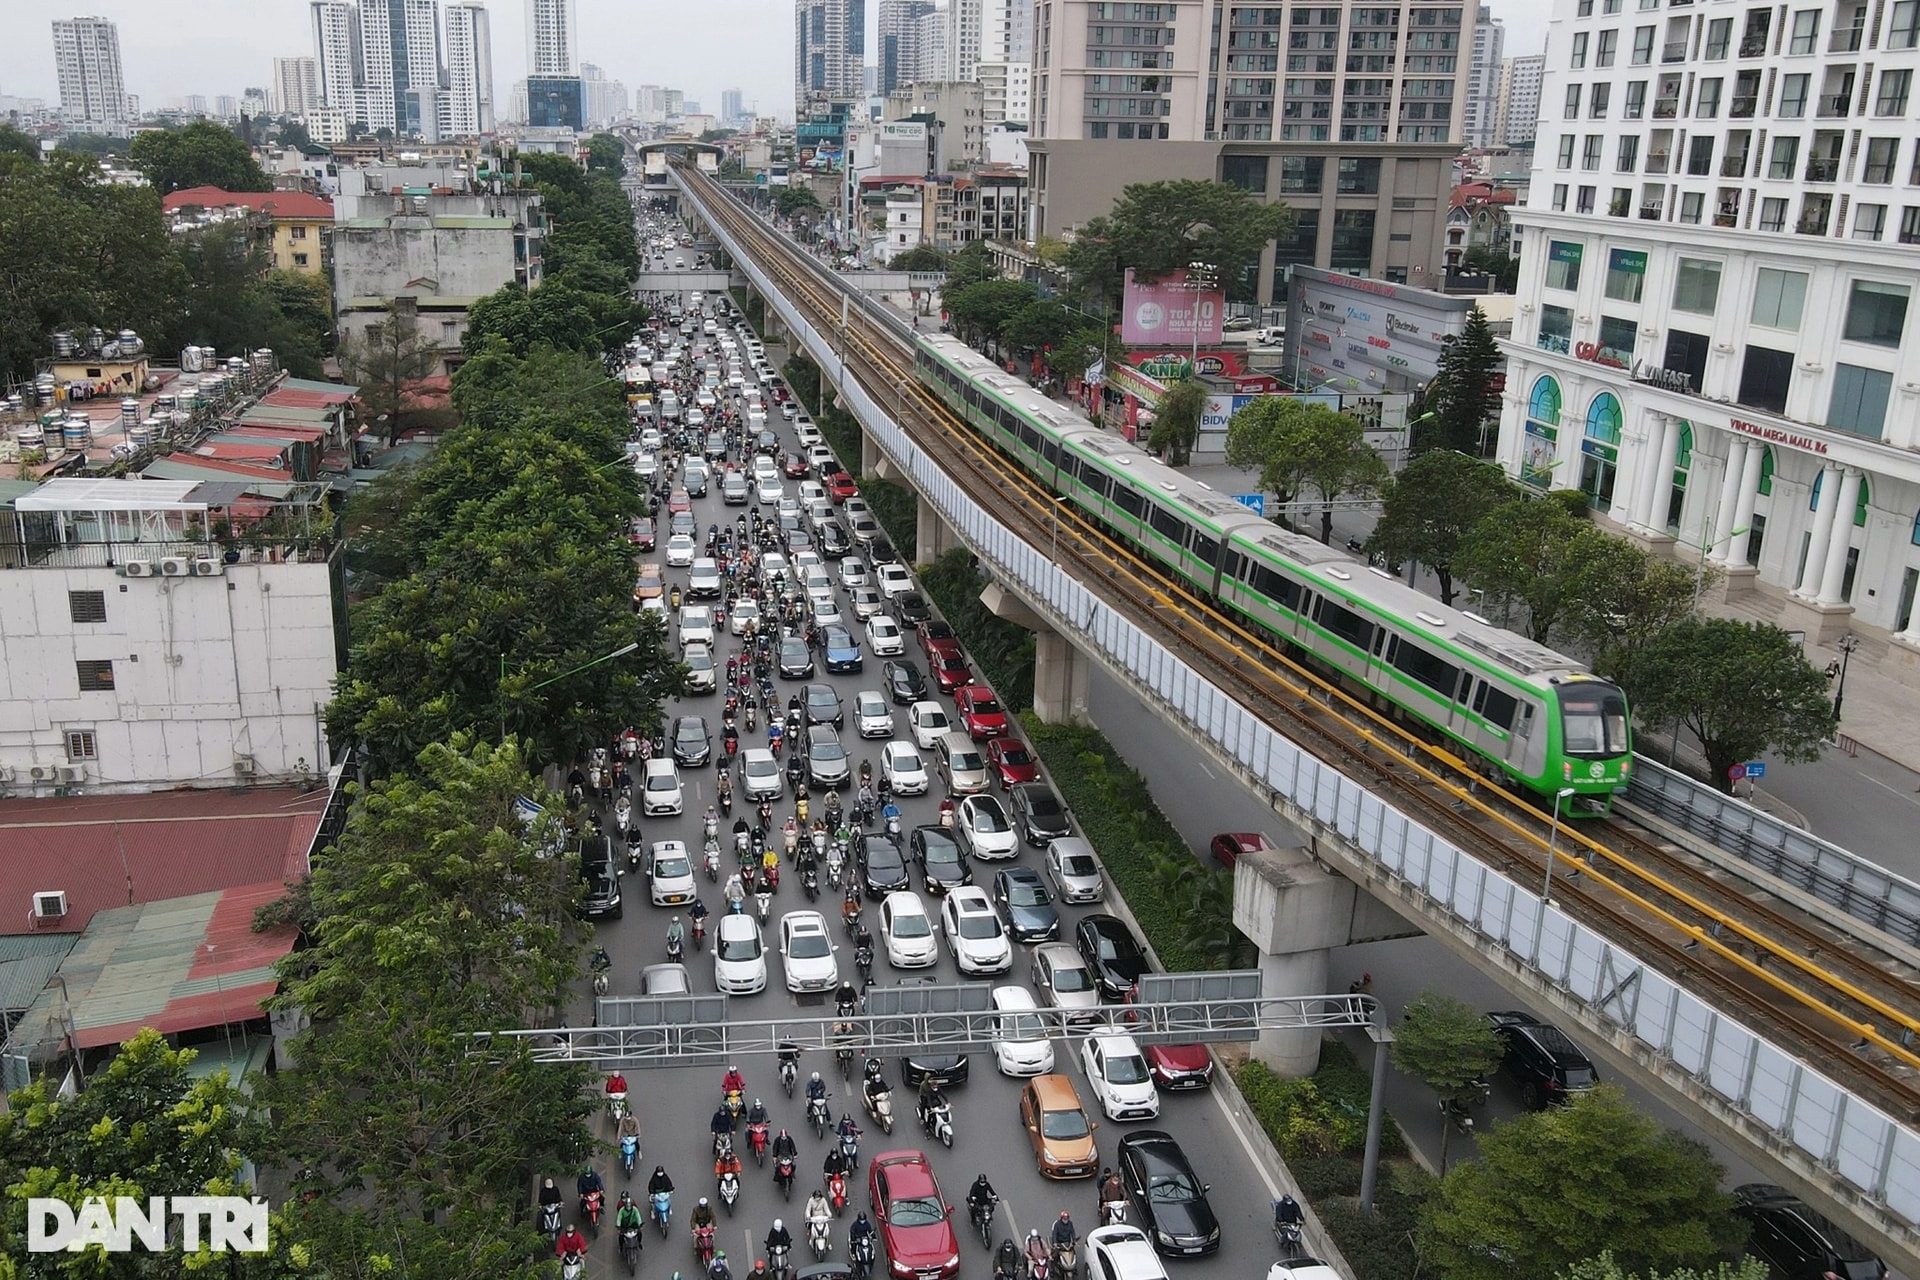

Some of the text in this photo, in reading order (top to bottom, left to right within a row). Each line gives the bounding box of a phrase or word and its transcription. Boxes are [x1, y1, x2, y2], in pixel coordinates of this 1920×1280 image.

[1169, 309, 1191, 319] TOP
[1193, 300, 1215, 319] 10
[1367, 335, 1391, 350] SHARP
[1575, 341, 1602, 361] CGV
[1644, 364, 1692, 387] VINFAST
[1202, 415, 1228, 426] BIDV
[1730, 418, 1828, 455] VINCOM MEGA MALL R6
